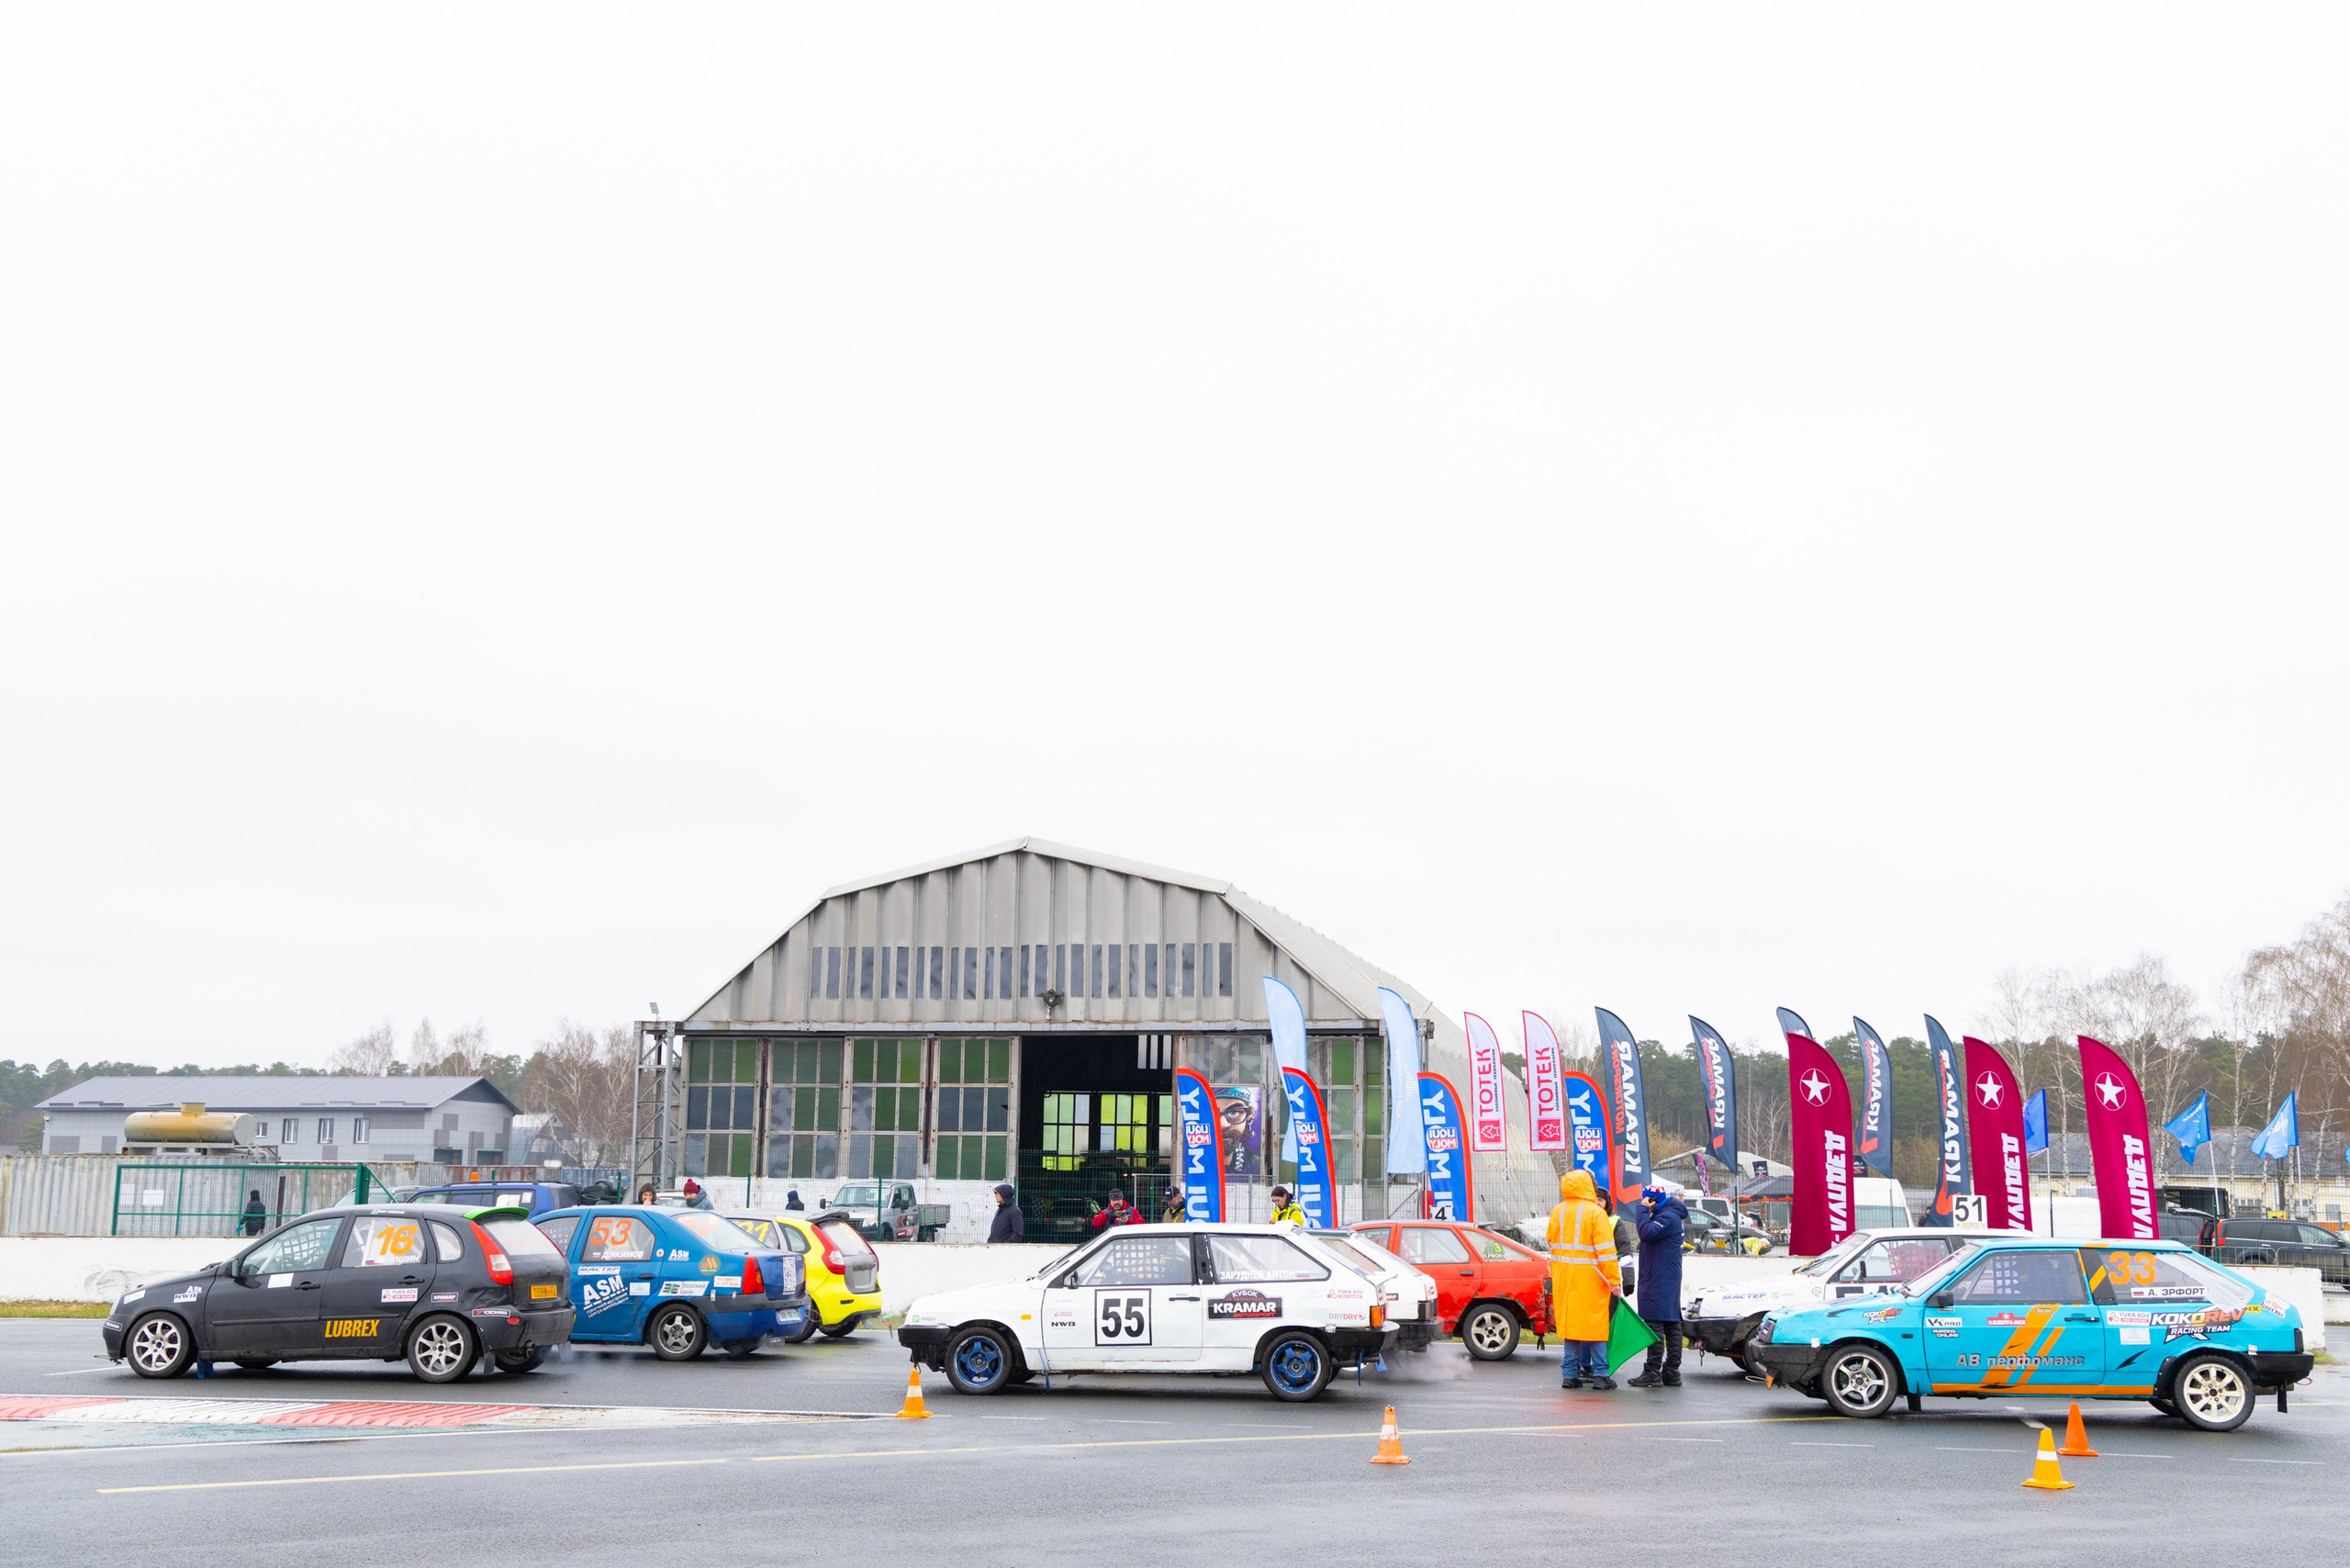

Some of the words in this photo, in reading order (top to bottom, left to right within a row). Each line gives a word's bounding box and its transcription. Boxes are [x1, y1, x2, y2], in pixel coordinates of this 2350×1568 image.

[1824, 1130, 1847, 1249] ДЭДПУЛ-
[1955, 1196, 1983, 1222] 51
[590, 1218, 632, 1245] 53
[375, 1224, 419, 1256] 16
[389, 1254, 420, 1263] ЮШИН
[600, 1250, 644, 1260] Д.ЯКИМОВ
[1220, 1270, 1264, 1281] ЗАРУДНЕВ
[1266, 1270, 1296, 1279] АНТОН
[2109, 1251, 2156, 1285] 33
[583, 1274, 625, 1306] ASM
[680, 1282, 706, 1291] Земский
[1231, 1290, 1259, 1298] КУБОК
[2148, 1288, 2158, 1296] А.
[2162, 1288, 2205, 1296] ЭРФОРТ
[1722, 1292, 1767, 1301] МАСТЕР
[1213, 1302, 1277, 1314] KRAMAR
[1863, 1308, 1903, 1317] KOKOREV
[1101, 1297, 1146, 1338] 55
[2151, 1308, 2245, 1326] KOKOREV
[324, 1319, 380, 1338] LUBREX
[2171, 1327, 2204, 1335] RACING
[2207, 1325, 2231, 1333] TEAM
[1955, 1353, 1981, 1367] АВ
[1986, 1352, 2086, 1370] перфоманс
